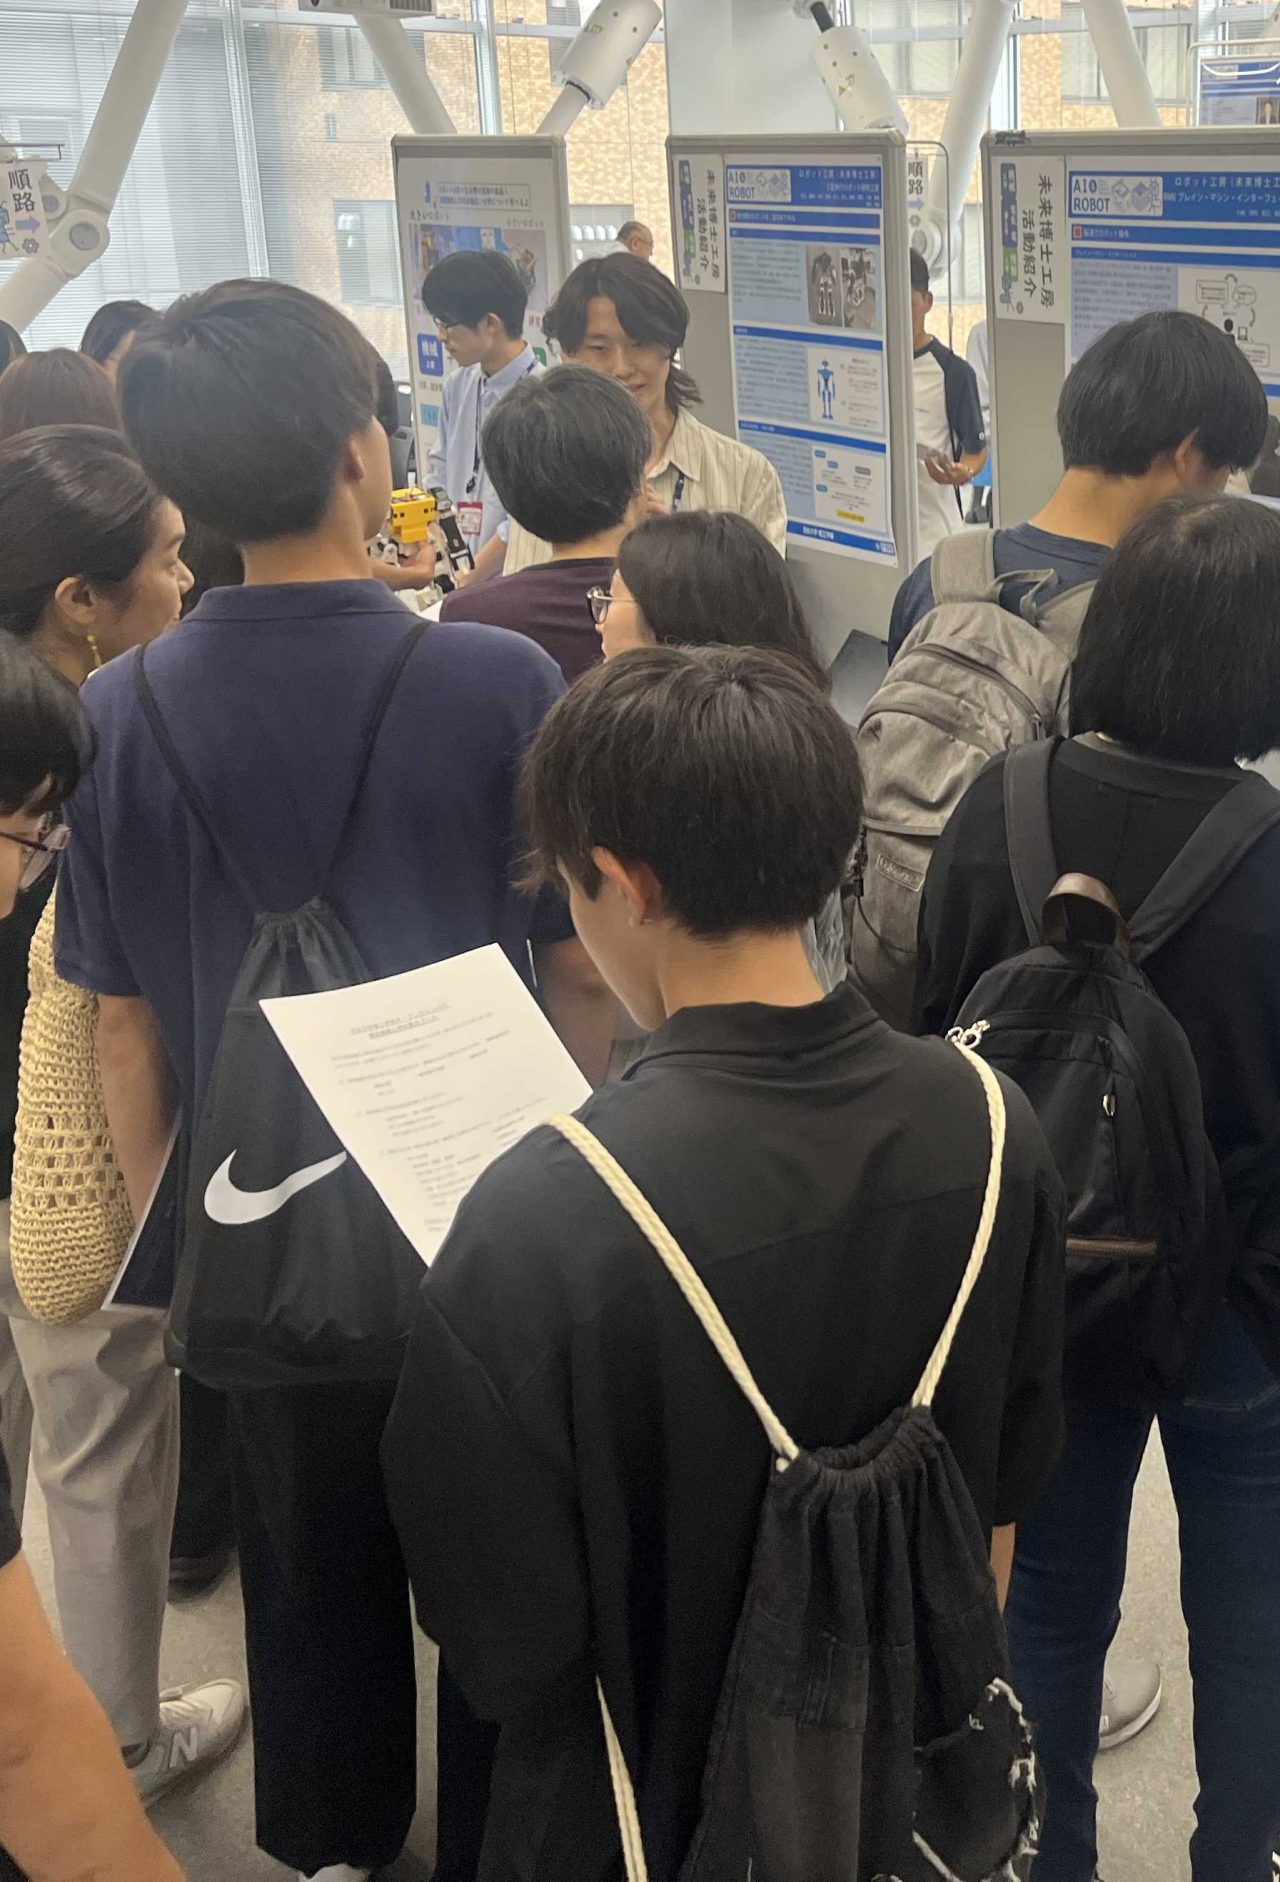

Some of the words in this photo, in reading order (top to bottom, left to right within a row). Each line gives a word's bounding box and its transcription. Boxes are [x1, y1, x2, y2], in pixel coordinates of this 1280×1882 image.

[8, 169, 35, 213] 順路
[729, 186, 756, 199] ROBOT
[908, 162, 924, 195] 順路
[1073, 179, 1097, 194] AIO
[1073, 197, 1111, 213] ROBOT
[1022, 209, 1037, 298] 活動紹介
[1038, 174, 1054, 308] 未来博士工房
